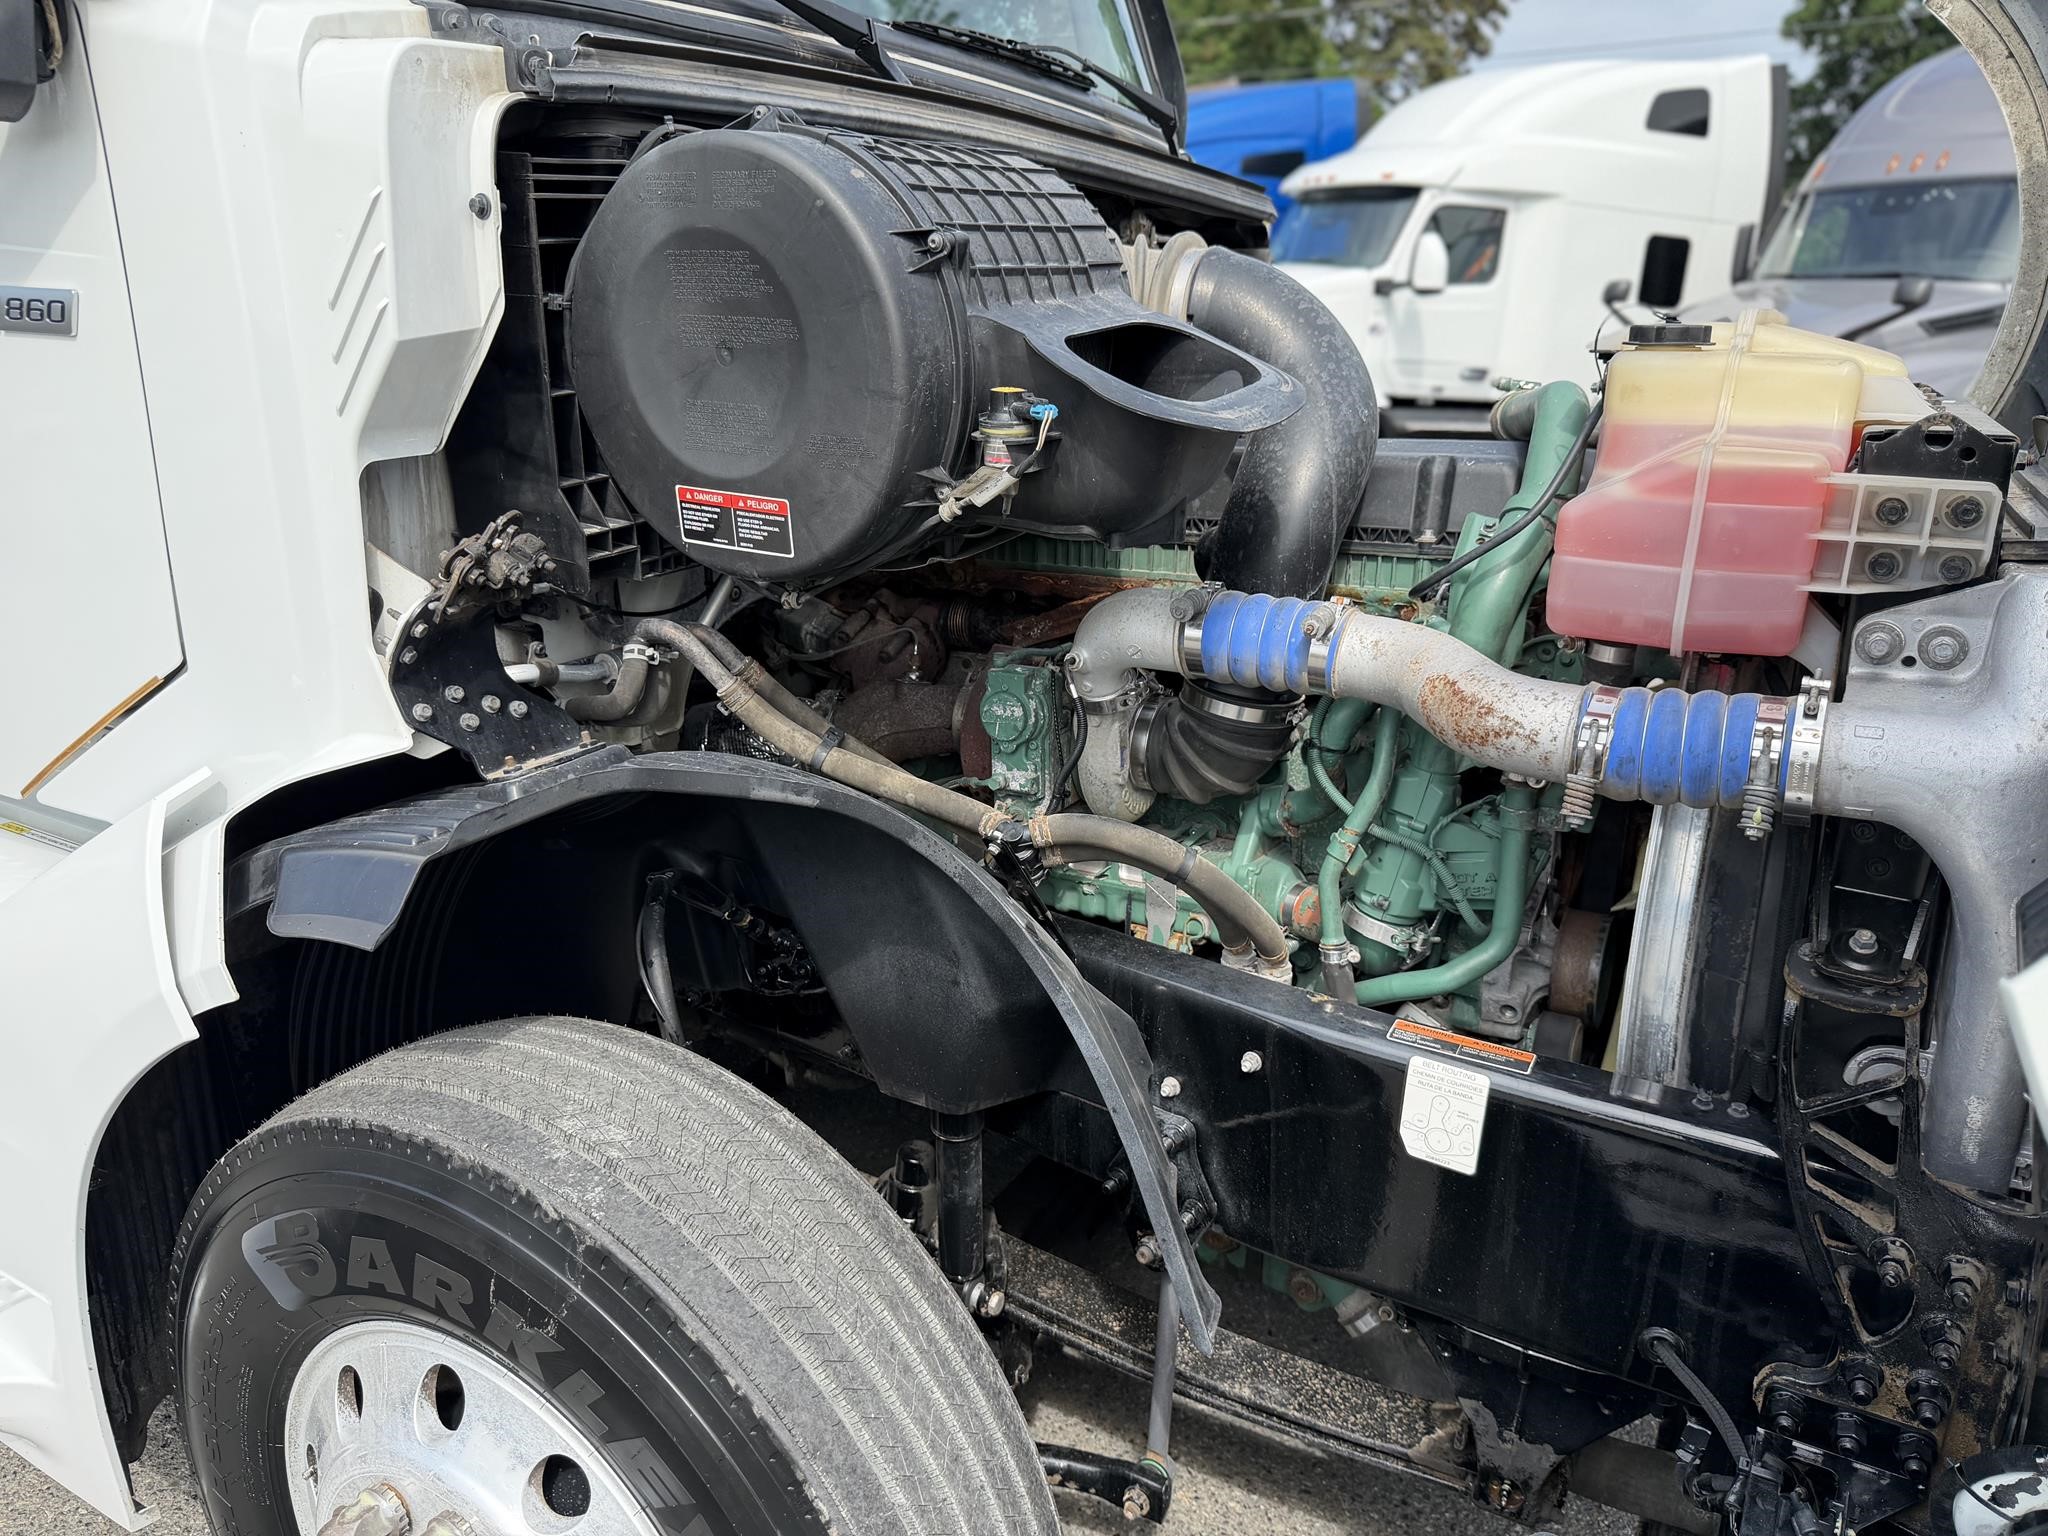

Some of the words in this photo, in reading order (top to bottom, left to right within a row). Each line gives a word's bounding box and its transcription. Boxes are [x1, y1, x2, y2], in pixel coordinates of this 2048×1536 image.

[6, 298, 65, 323] 860
[694, 492, 723, 503] DANGER
[747, 500, 779, 511] PELIGRO
[1413, 1024, 1454, 1039] WARNING
[1482, 1043, 1525, 1056] CUIDADO
[1412, 1069, 1436, 1080] CHEMIN
[1422, 1061, 1440, 1071] BELT
[1442, 1066, 1476, 1082] ROUTING
[1417, 1080, 1433, 1089] RUTA
[1452, 1090, 1474, 1101] BANDA
